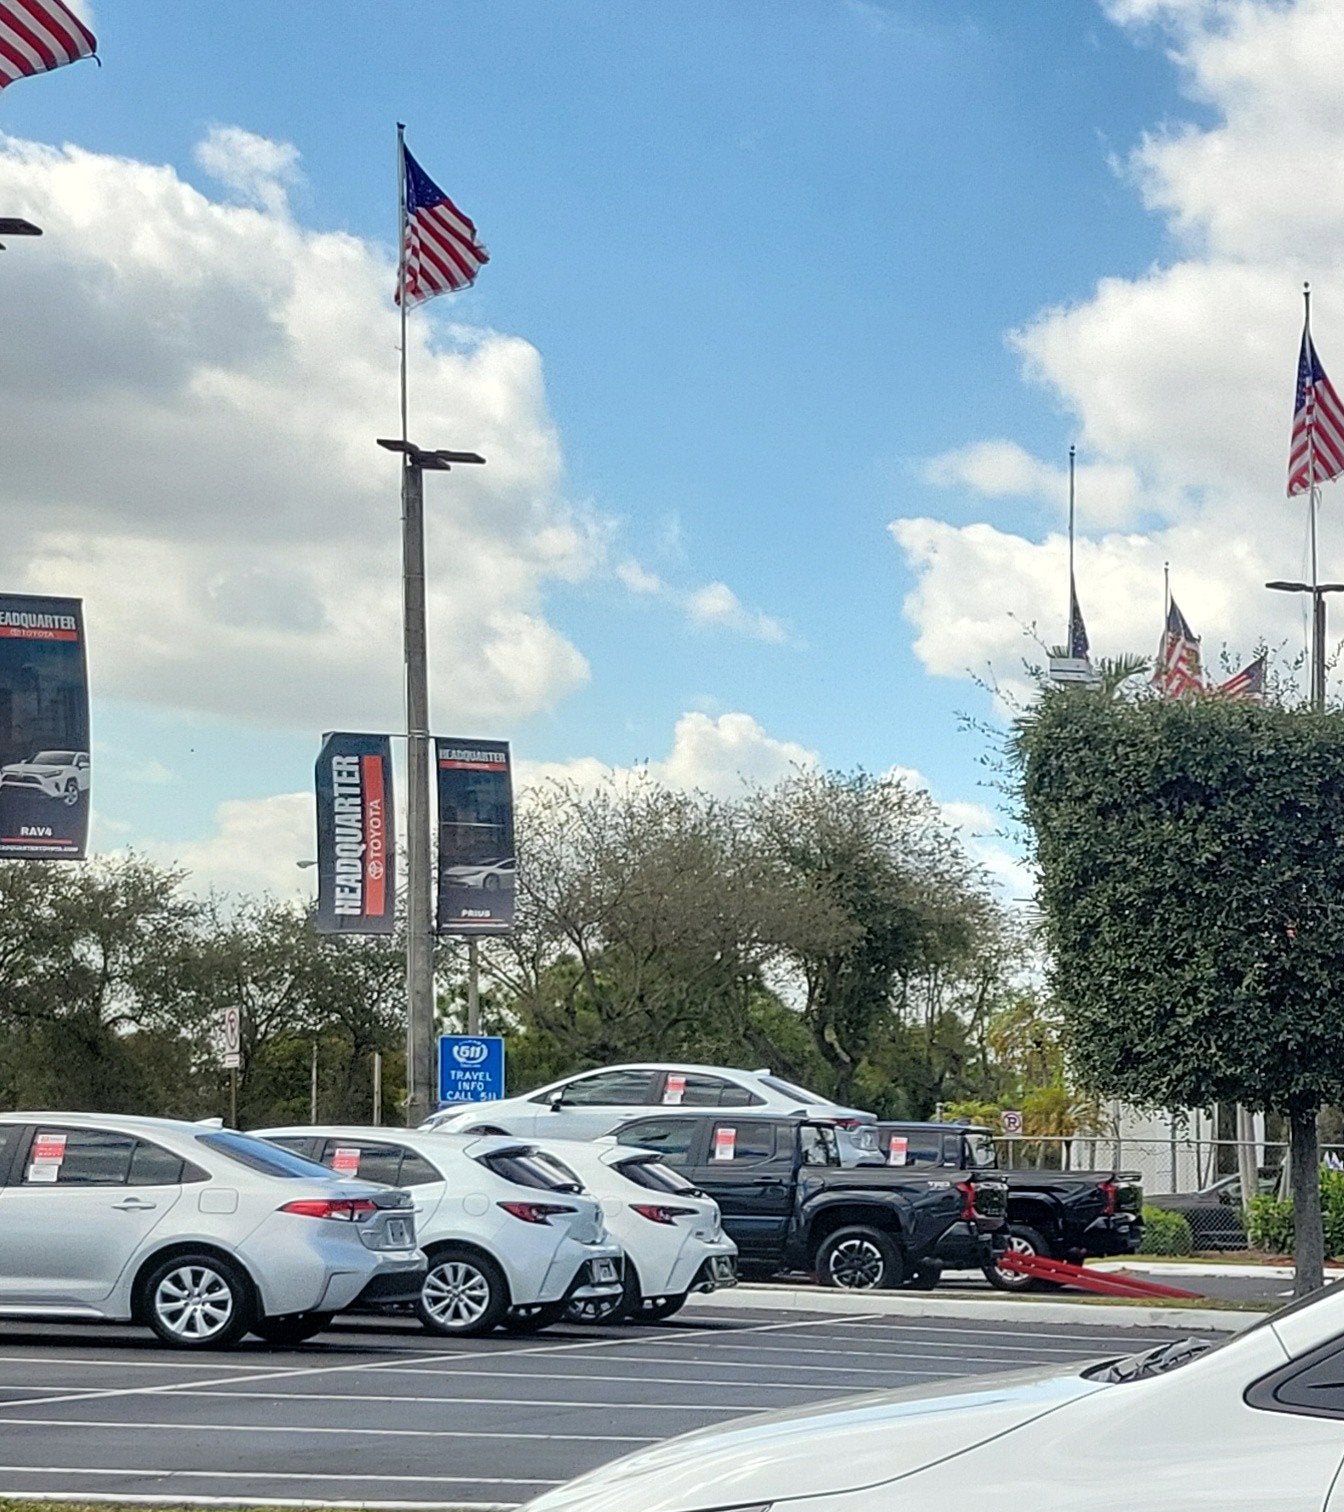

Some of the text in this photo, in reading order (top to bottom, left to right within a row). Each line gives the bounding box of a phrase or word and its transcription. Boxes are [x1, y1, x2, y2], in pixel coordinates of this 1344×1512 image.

[21, 628, 54, 638] TOYOTA
[439, 749, 506, 763] HEADQUARTER
[20, 826, 53, 837] RAV4
[369, 799, 381, 859] TOYOTA
[332, 755, 365, 915] HEADQUARTER
[461, 909, 490, 917] PRIUS
[450, 1070, 492, 1081] TRAVEL
[458, 1081, 484, 1091] INFO
[446, 1091, 497, 1101] CALL 511
